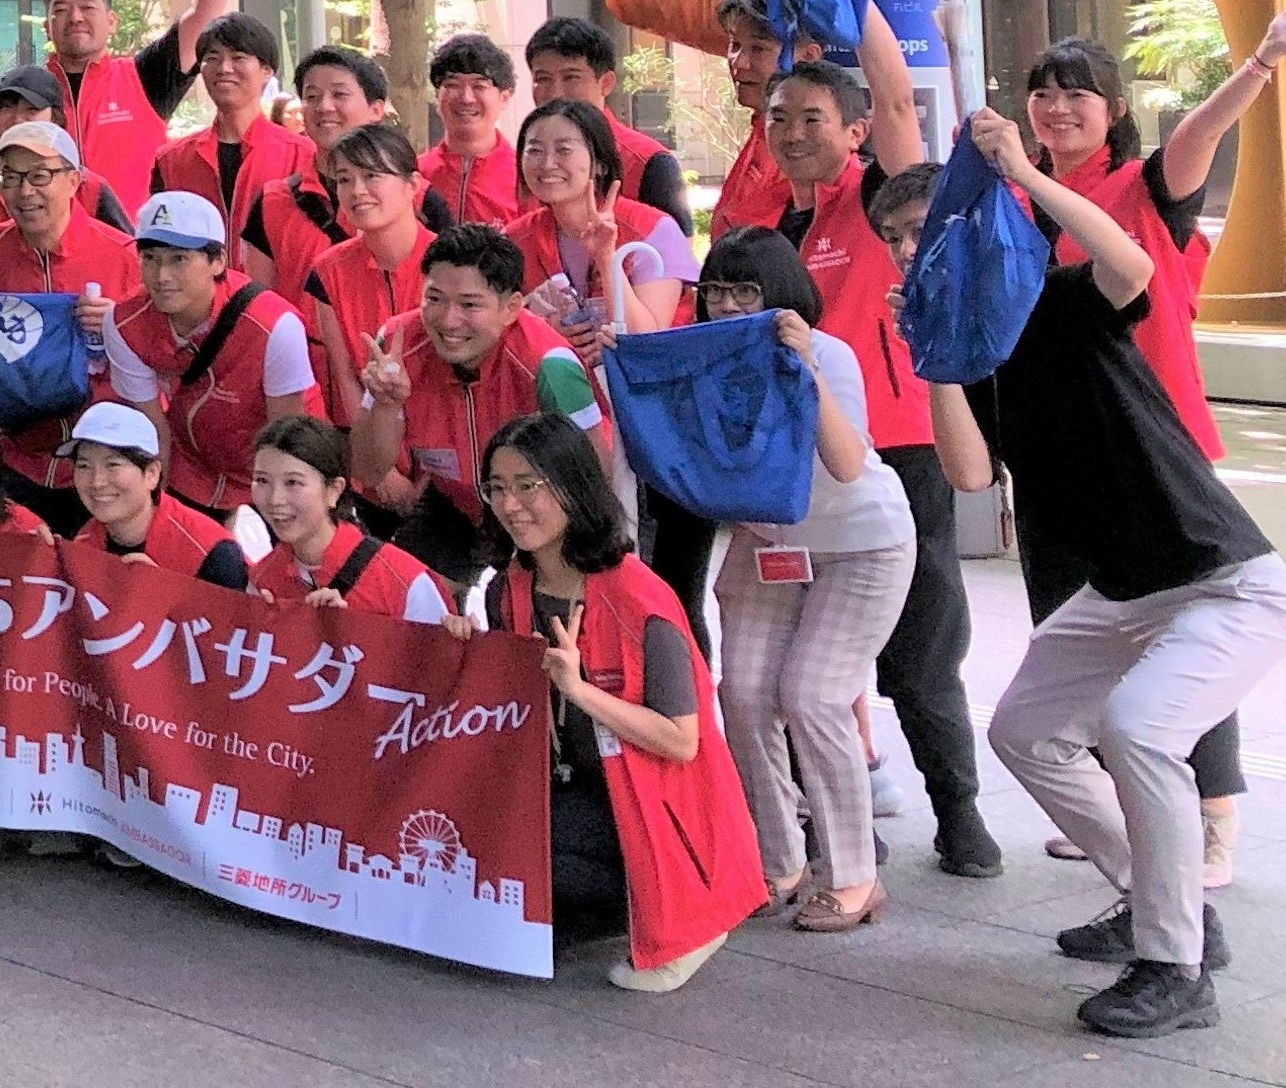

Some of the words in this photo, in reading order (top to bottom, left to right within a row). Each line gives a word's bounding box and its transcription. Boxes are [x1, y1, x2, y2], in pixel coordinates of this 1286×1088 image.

[900, 37, 929, 57] ops
[3, 667, 37, 693] for
[105, 696, 117, 721] A
[121, 702, 177, 739] Love
[185, 721, 218, 750] for
[224, 731, 259, 760] the
[266, 741, 316, 778] City.
[374, 699, 532, 759] Action
[218, 863, 342, 910] 三菱地所グループ
